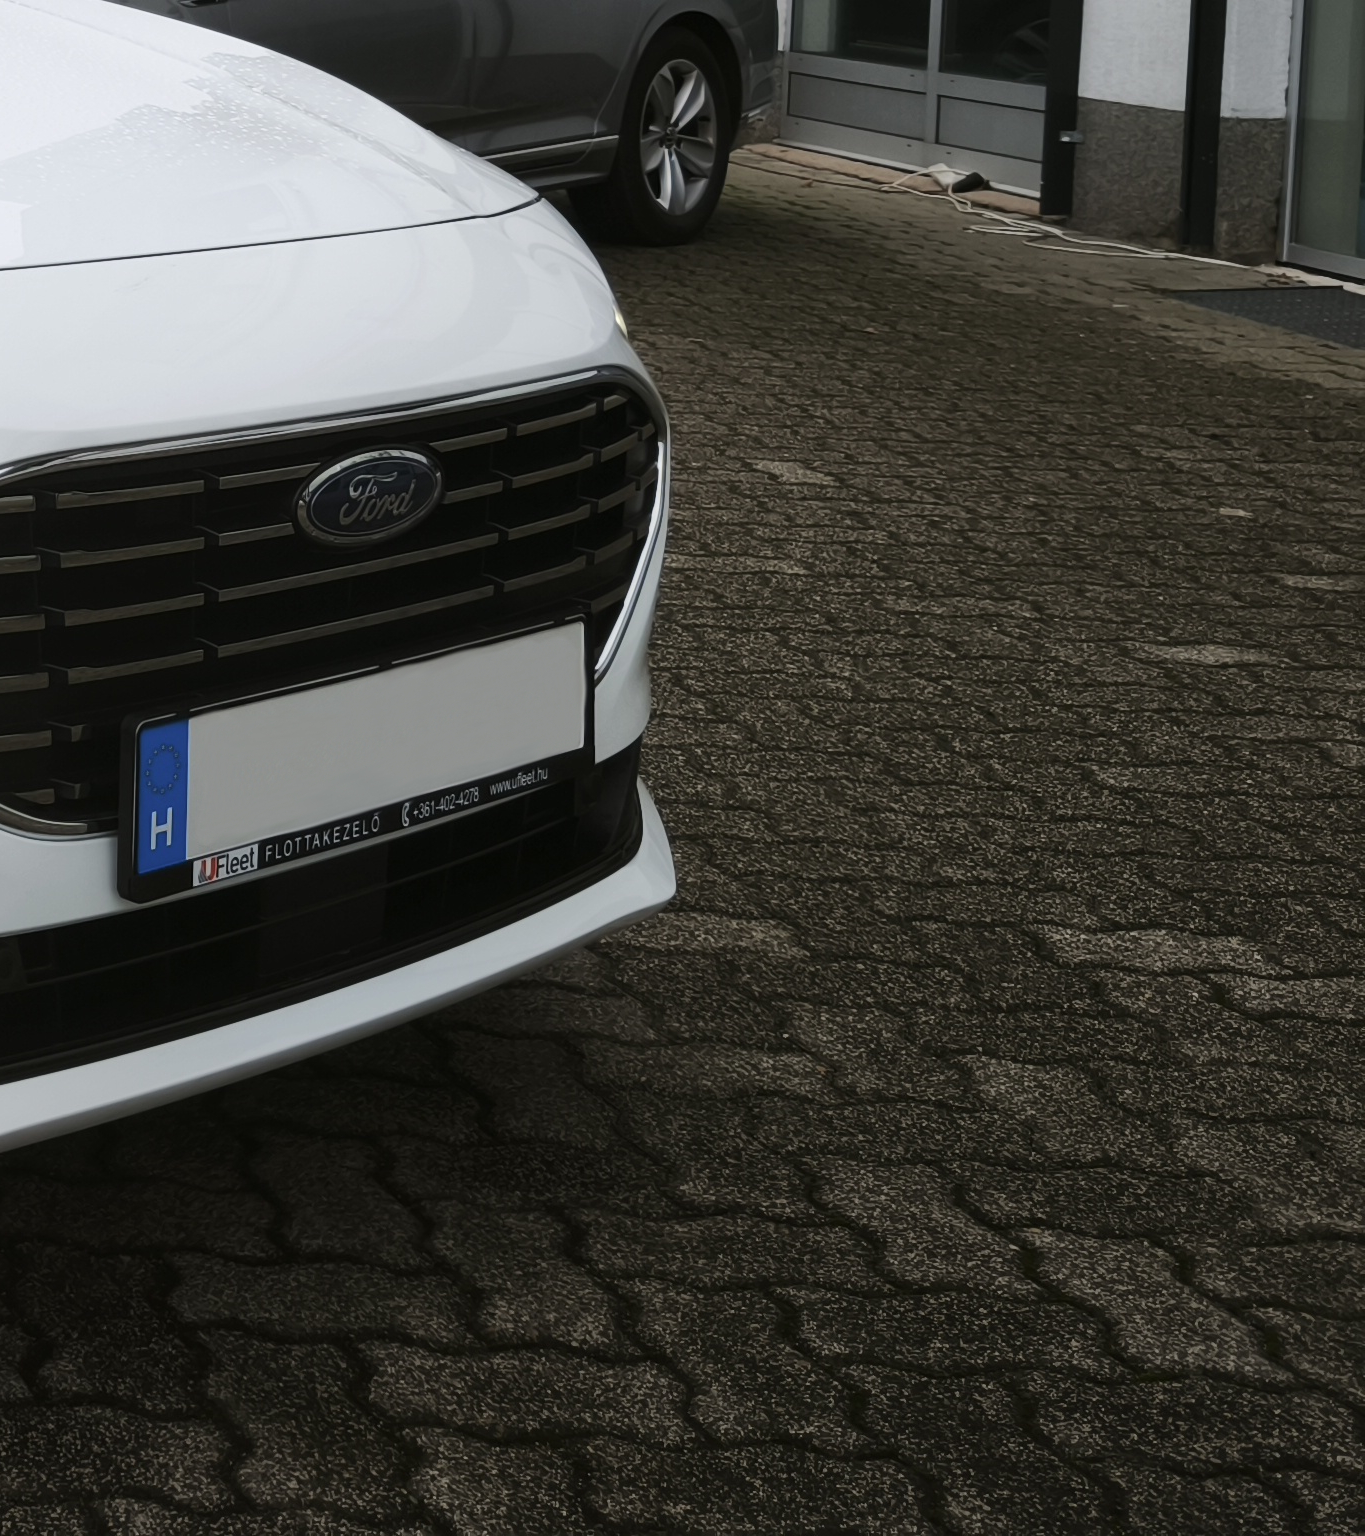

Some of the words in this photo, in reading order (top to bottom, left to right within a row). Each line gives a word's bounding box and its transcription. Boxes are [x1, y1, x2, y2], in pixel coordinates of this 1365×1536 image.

[339, 471, 416, 526] Ford
[413, 786, 480, 819] +361-402-4278
[489, 767, 549, 796] www.ufleet.hu
[150, 806, 173, 851] H
